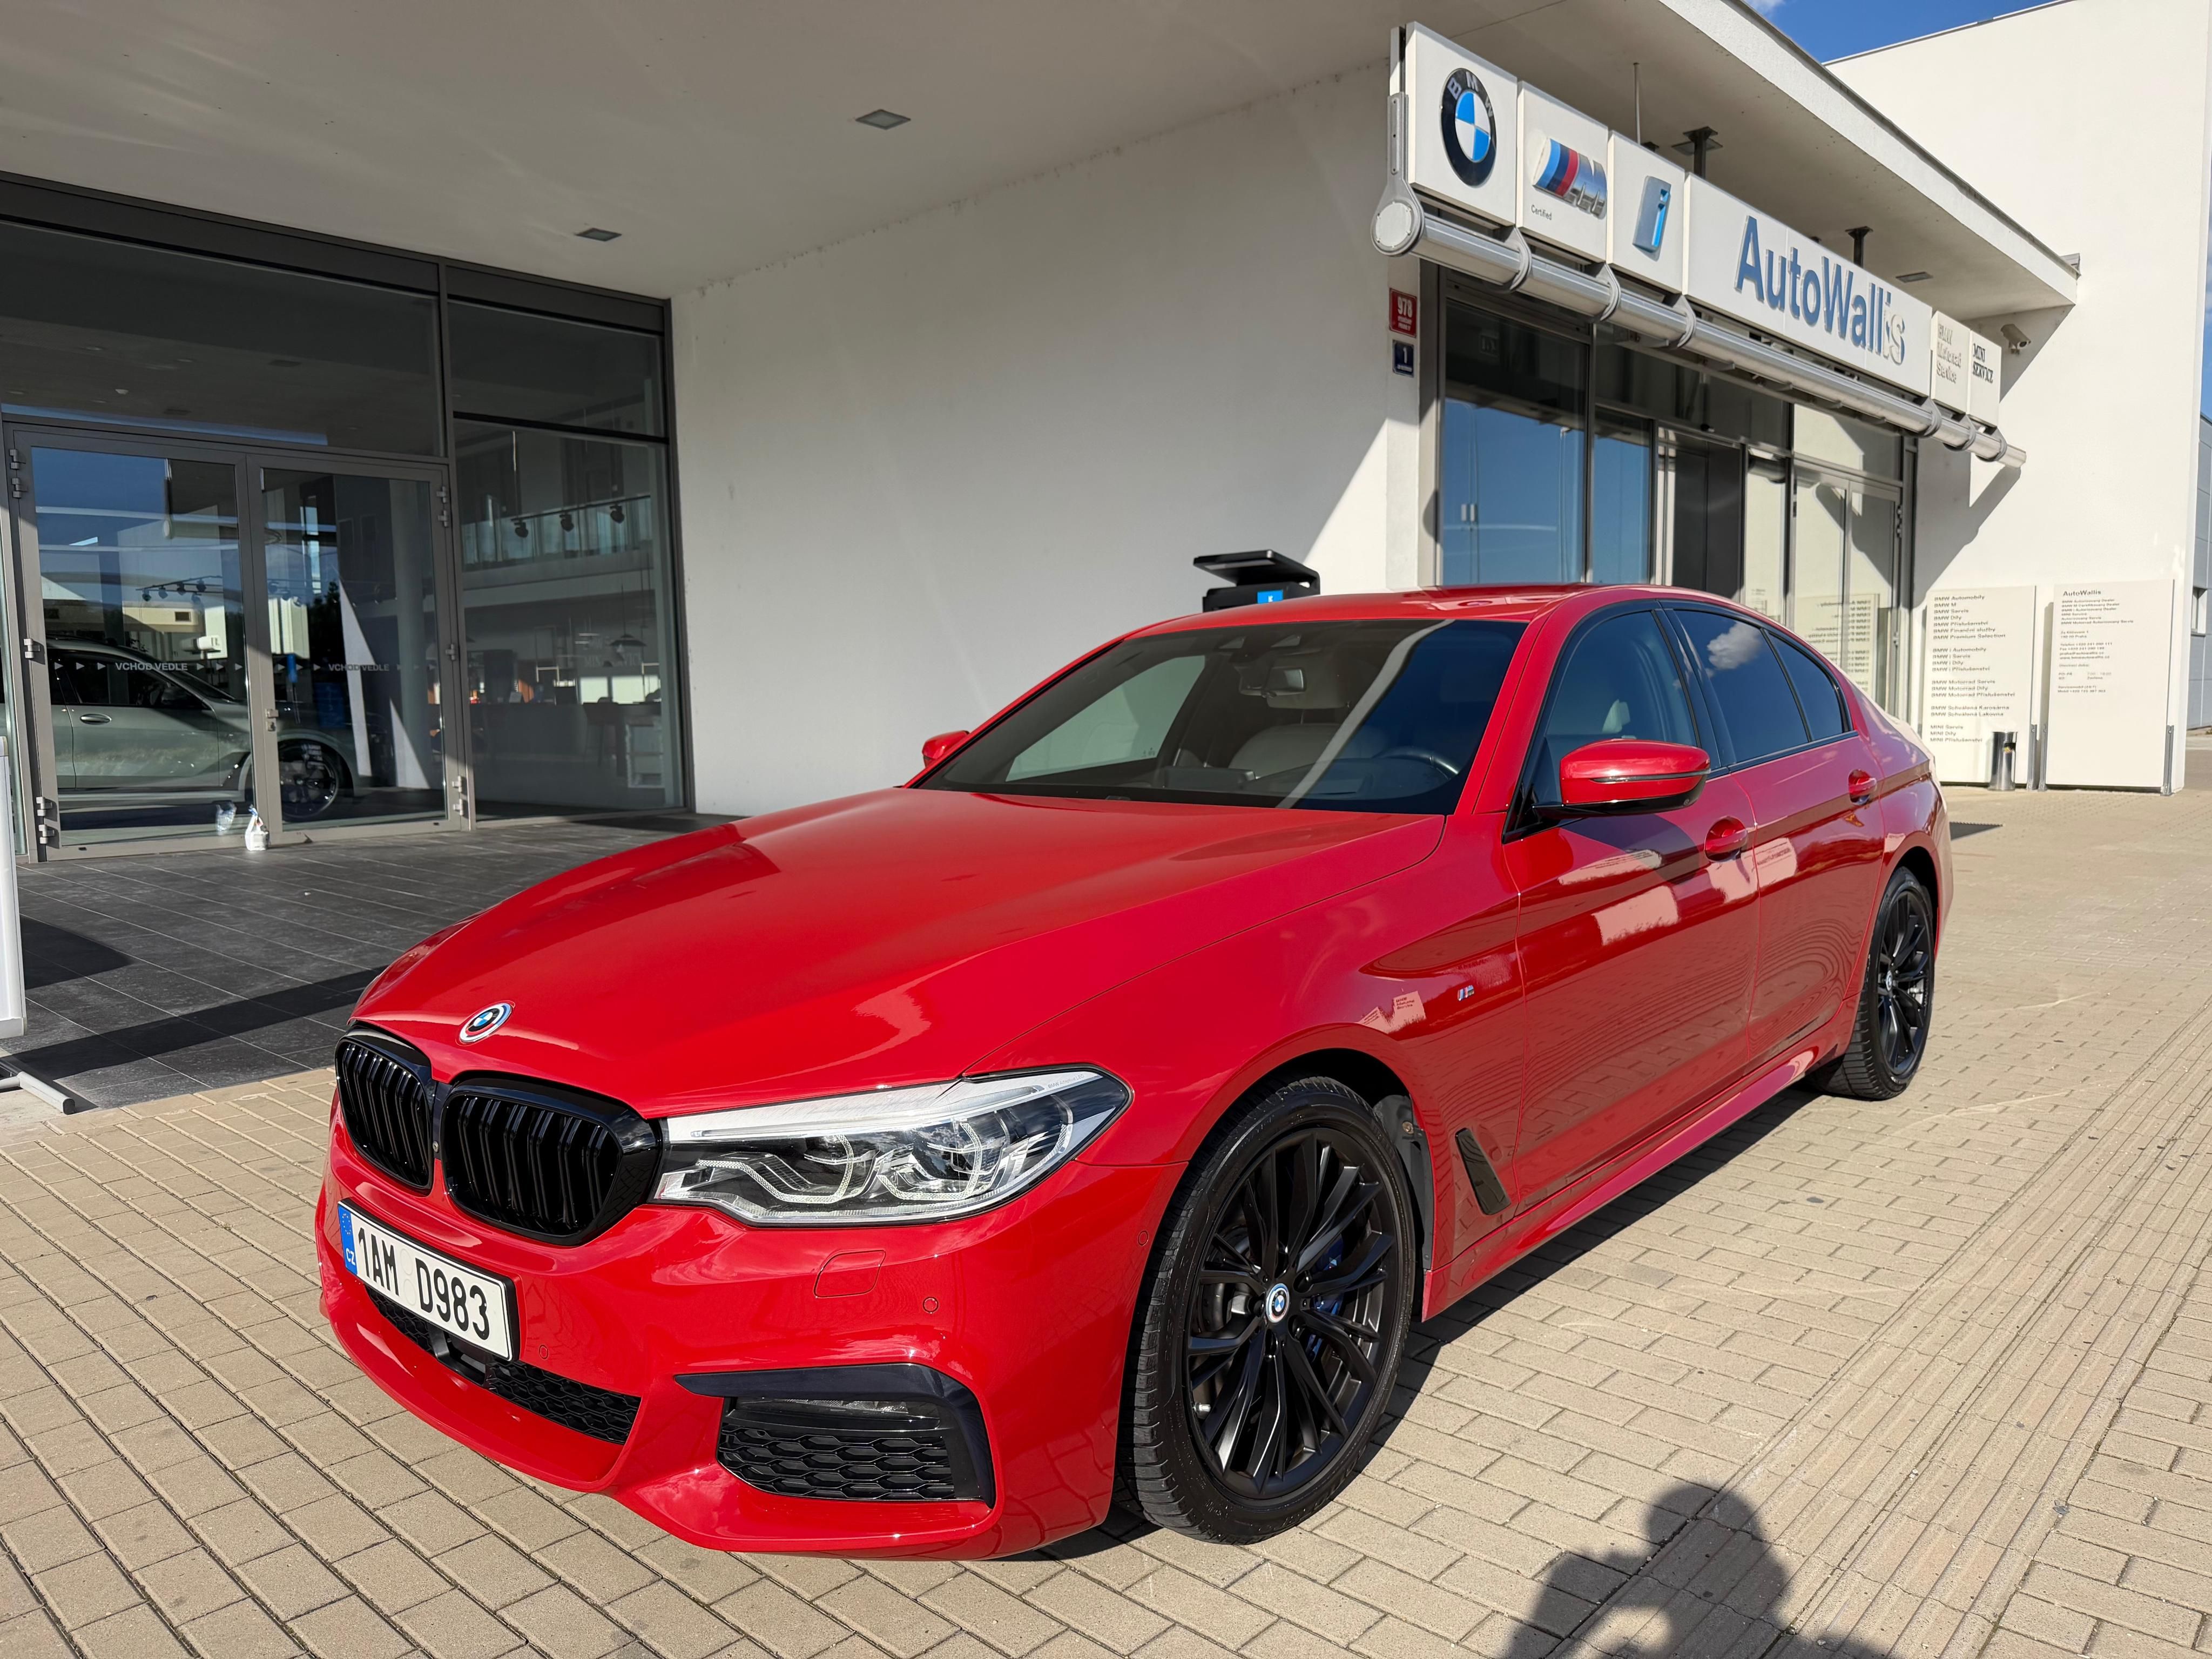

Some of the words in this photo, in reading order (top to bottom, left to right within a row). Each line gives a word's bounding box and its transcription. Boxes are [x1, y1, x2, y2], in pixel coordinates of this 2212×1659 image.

[1447, 71, 1494, 118] BMW
[1530, 205, 1552, 220] Certified
[1734, 215, 1905, 366] AutoWallis
[1397, 296, 1413, 319] 978
[115, 662, 152, 671] VCHOD
[154, 663, 188, 671] VEDLE
[328, 663, 360, 671] VCHOD
[346, 1247, 356, 1265] CZ
[358, 1227, 399, 1297] 1AM
[415, 1257, 490, 1340] D983
